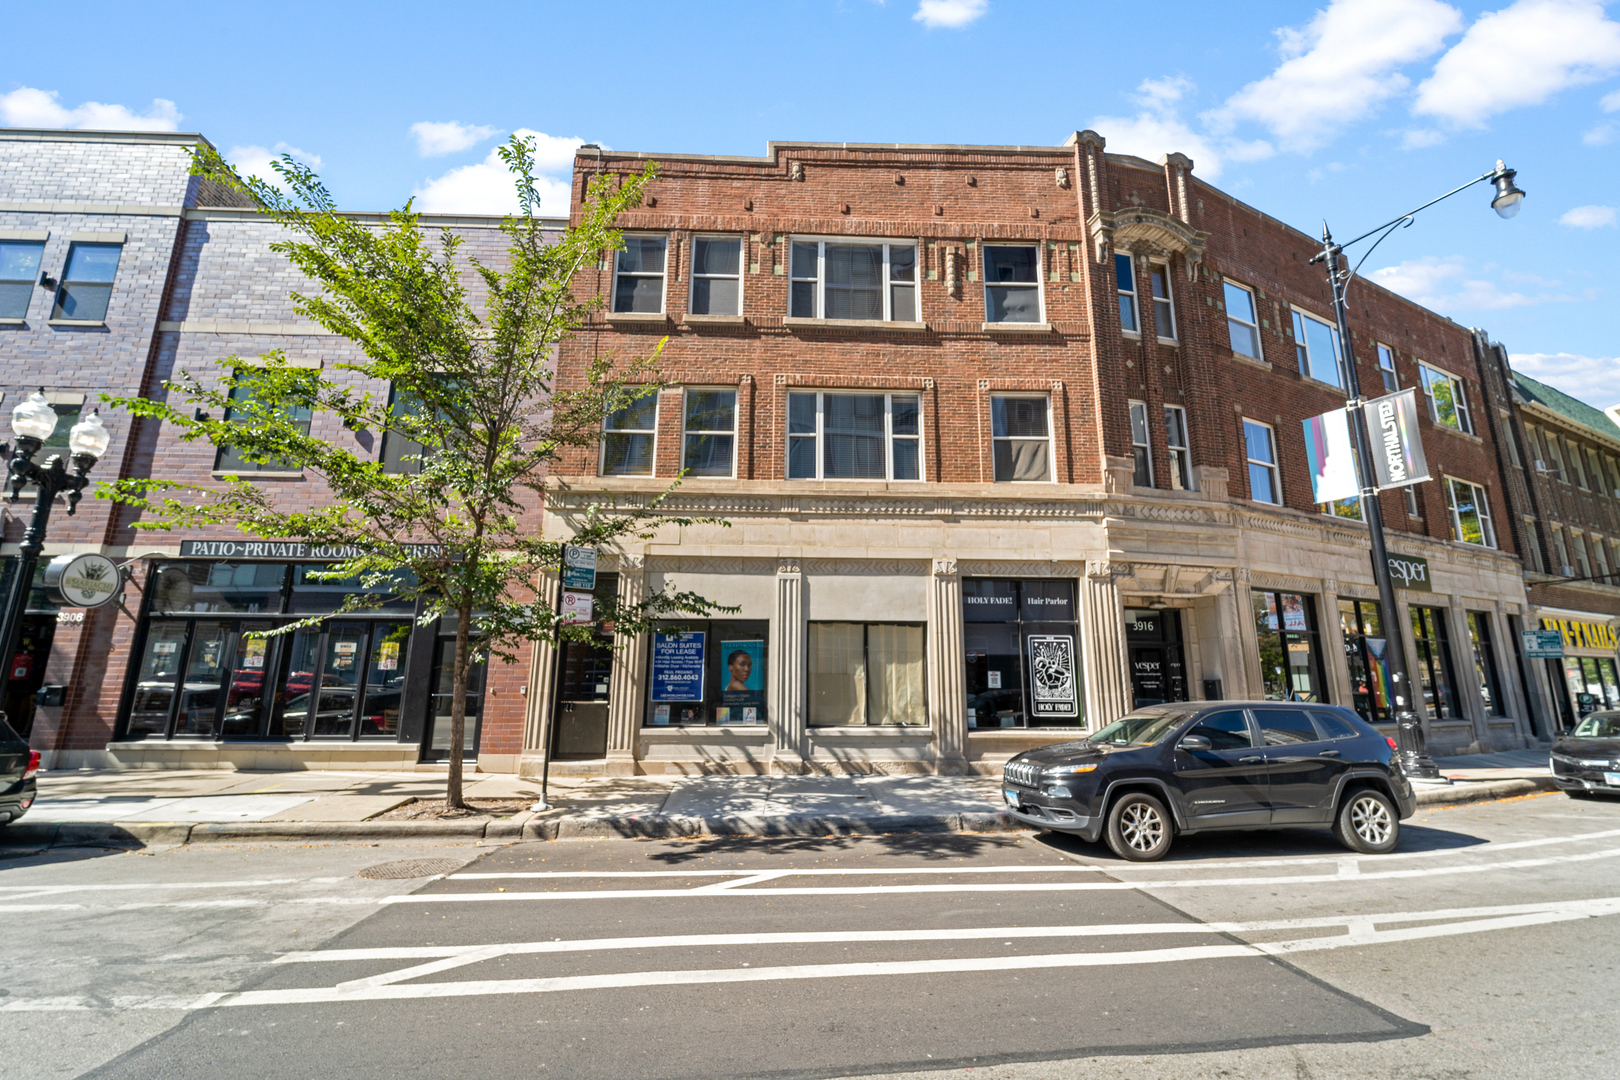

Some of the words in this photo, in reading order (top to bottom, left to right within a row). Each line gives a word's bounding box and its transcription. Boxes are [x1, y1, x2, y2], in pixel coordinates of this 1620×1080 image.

[1378, 401, 1406, 482] NORTHALSTED
[1388, 558, 1426, 587] esper
[72, 579, 114, 591] MARIACHI
[968, 597, 989, 605] HOLY
[990, 597, 1013, 605] FADE!
[1027, 597, 1044, 605] Hair
[1045, 597, 1068, 605] Parlor
[56, 612, 84, 622] 3906
[1133, 621, 1154, 631] 3916
[1581, 622, 1618, 649] NAILS
[1134, 662, 1160, 672] vesper
[1038, 703, 1054, 711] HOLY
